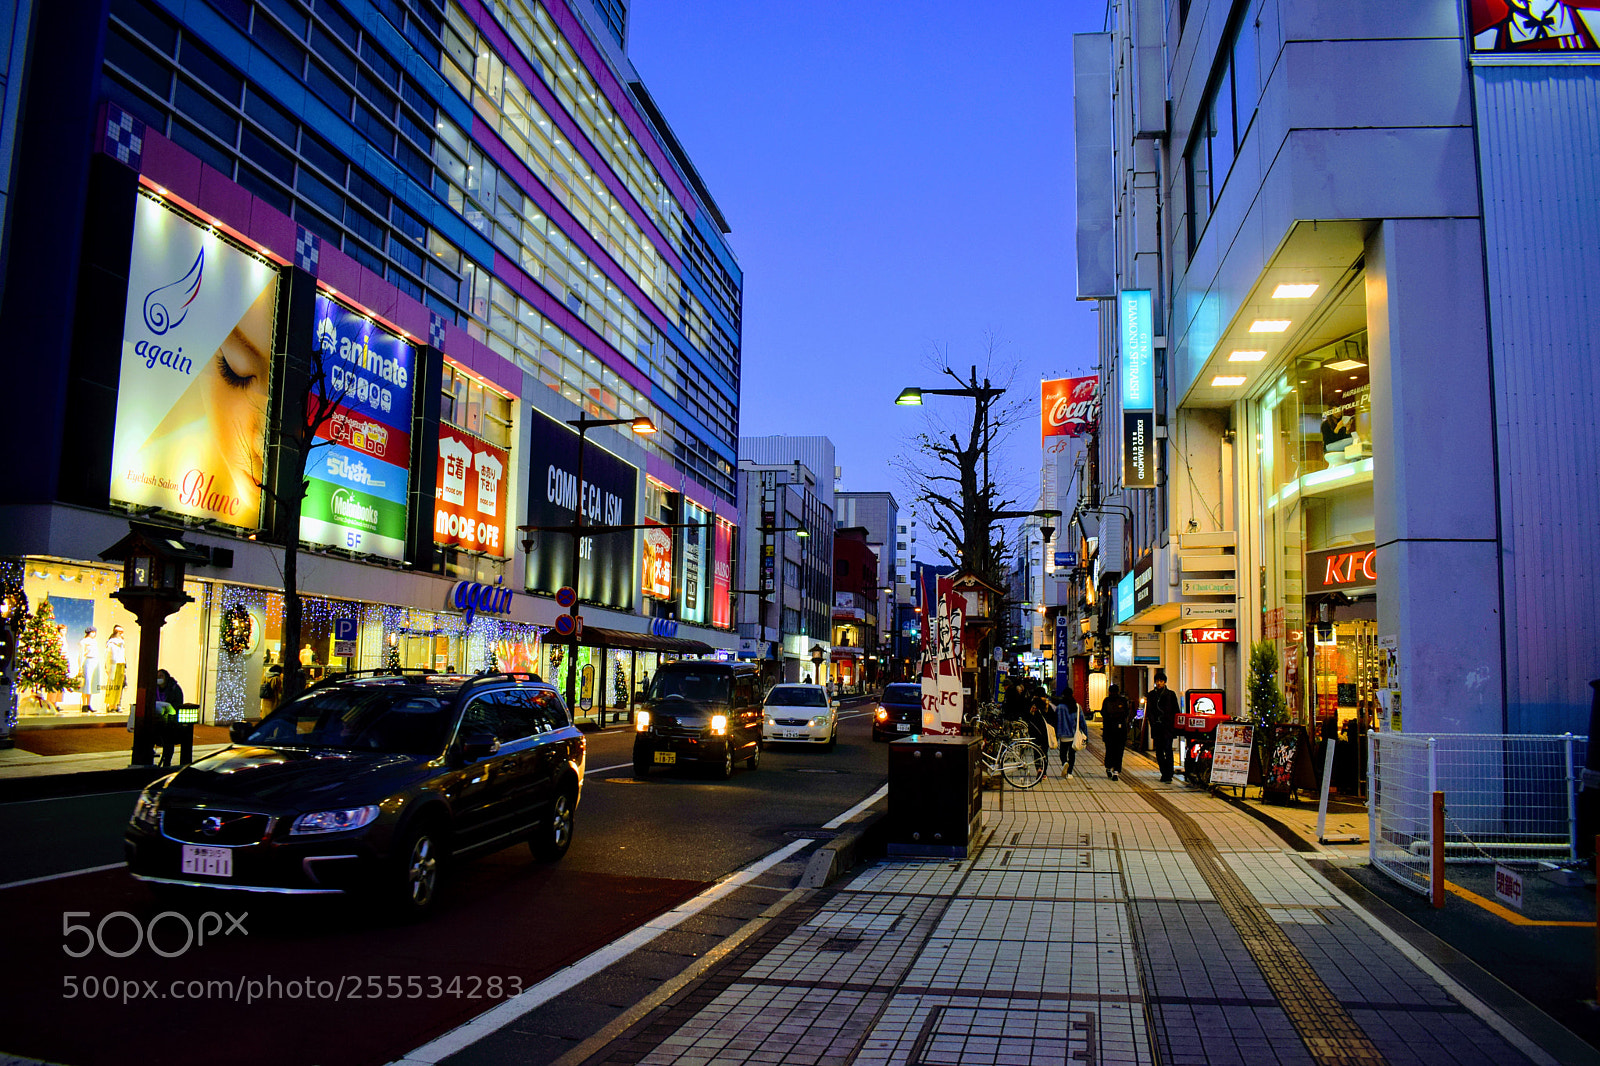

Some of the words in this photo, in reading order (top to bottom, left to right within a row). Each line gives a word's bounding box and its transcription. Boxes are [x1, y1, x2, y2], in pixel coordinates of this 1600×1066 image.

[1128, 300, 1138, 349] DIAMOND
[134, 339, 193, 375] again
[340, 334, 408, 388] animate
[1140, 333, 1148, 366] GINZA
[1129, 351, 1139, 400] SHIRAISHI
[1342, 400, 1360, 411] POULE
[447, 452, 464, 481] 古着
[481, 464, 496, 480] お売り
[127, 469, 157, 487] Eyelash
[157, 477, 179, 491] Salon
[179, 468, 240, 516] Blanc
[480, 478, 496, 493] 下さい
[604, 491, 623, 526] ISM
[347, 532, 361, 548] 5F
[436, 509, 476, 542] MODE
[477, 521, 500, 548] OFF
[579, 536, 593, 560] B1F
[453, 575, 514, 625] again
[1185, 607, 1191, 616] 2
[340, 621, 352, 638] P
[1201, 631, 1231, 640] KFC
[194, 857, 228, 875] 11-11
